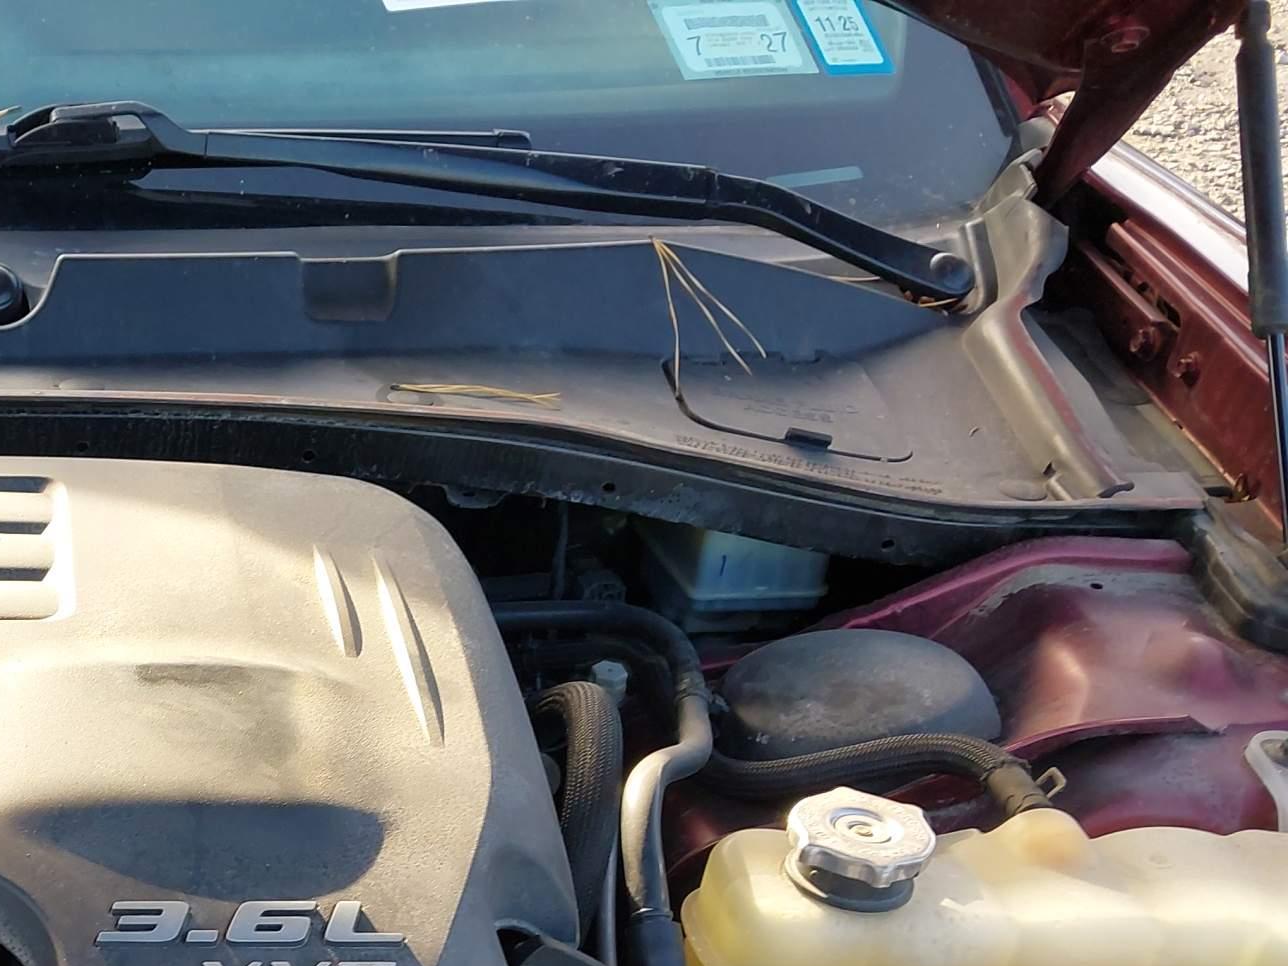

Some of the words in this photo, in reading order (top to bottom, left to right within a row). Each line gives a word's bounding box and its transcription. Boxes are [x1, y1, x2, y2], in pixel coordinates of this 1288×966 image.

[686, 36, 702, 56] 7
[760, 32, 787, 53] 27
[95, 899, 407, 946] 3.6L
